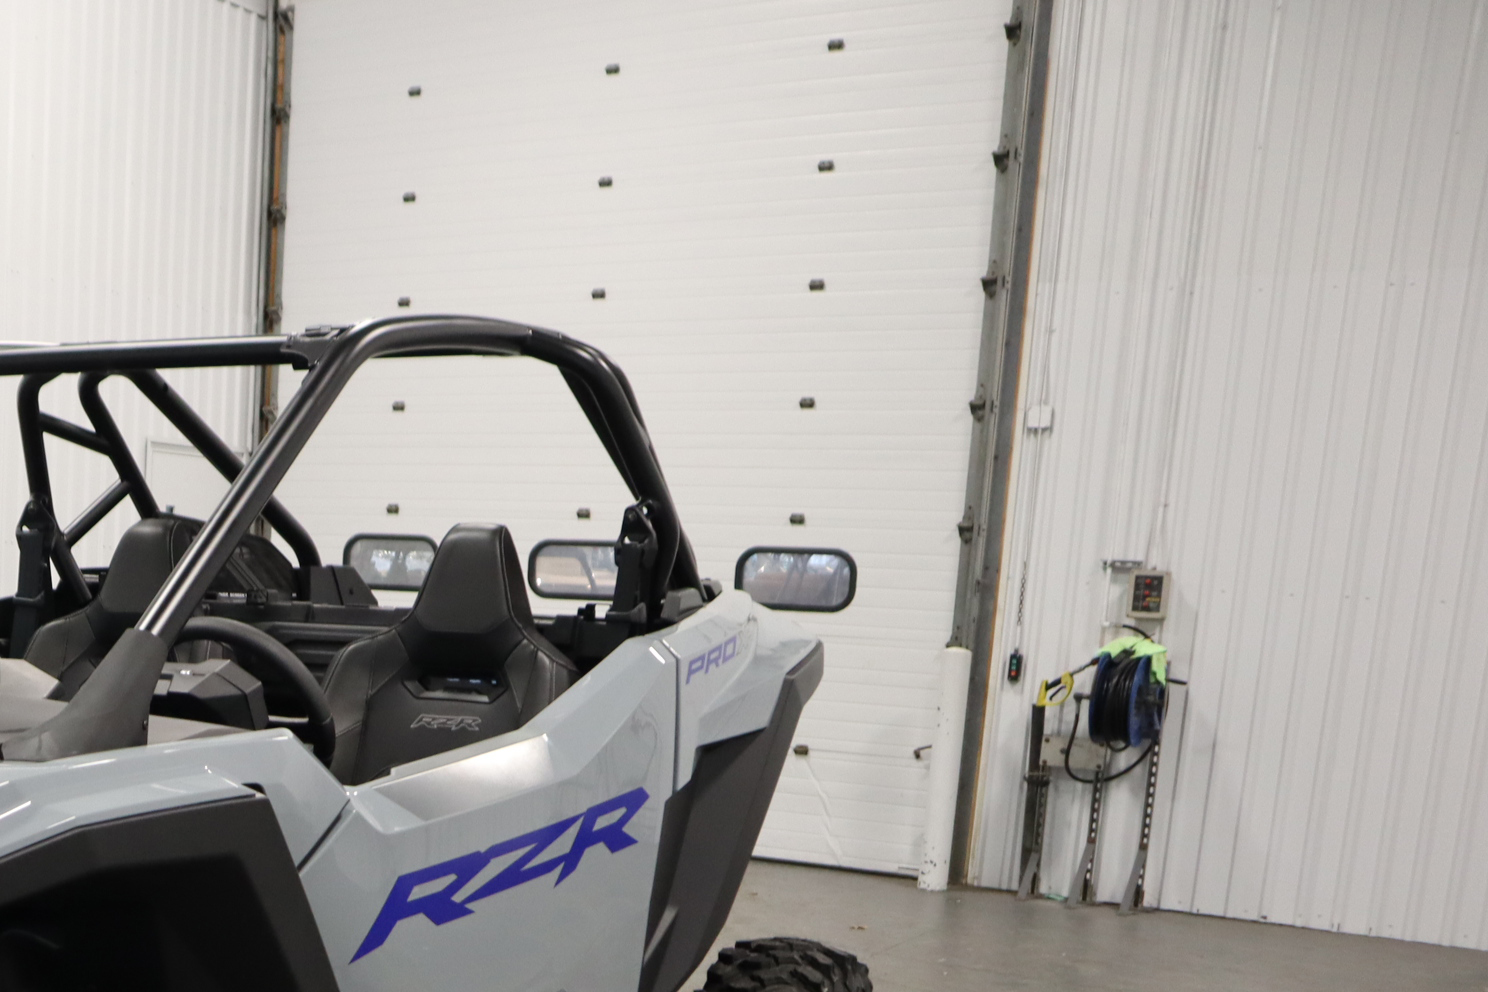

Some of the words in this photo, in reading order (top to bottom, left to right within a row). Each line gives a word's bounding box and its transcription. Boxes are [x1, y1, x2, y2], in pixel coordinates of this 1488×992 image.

[685, 634, 737, 685] PRO
[410, 713, 482, 731] RZR
[348, 786, 650, 966] RZR
